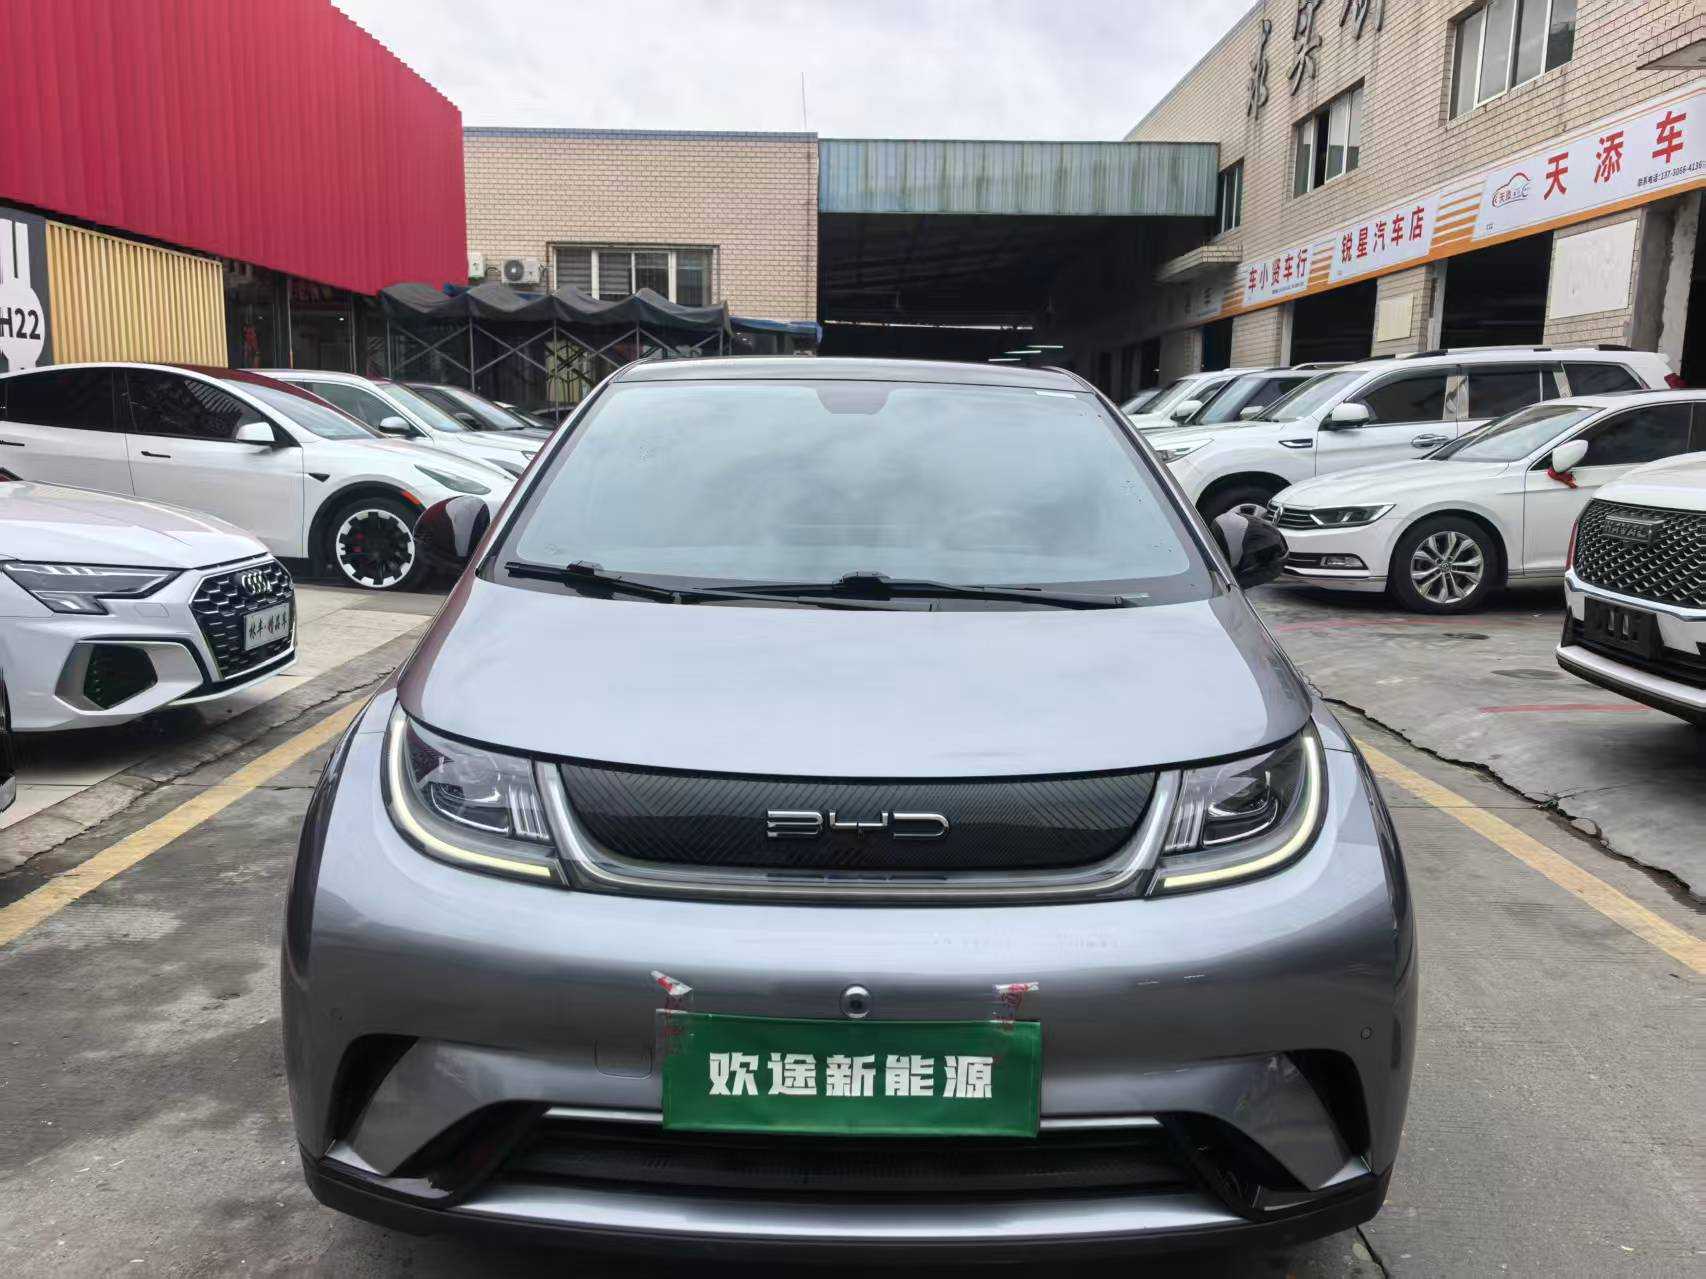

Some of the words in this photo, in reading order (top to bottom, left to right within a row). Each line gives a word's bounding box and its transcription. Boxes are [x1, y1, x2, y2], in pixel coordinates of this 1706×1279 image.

[1543, 111, 1687, 200] 天添车
[1341, 206, 1425, 264] 锐星汽车店
[767, 810, 950, 838] BYD
[708, 1052, 994, 1098] 欢途新能源
